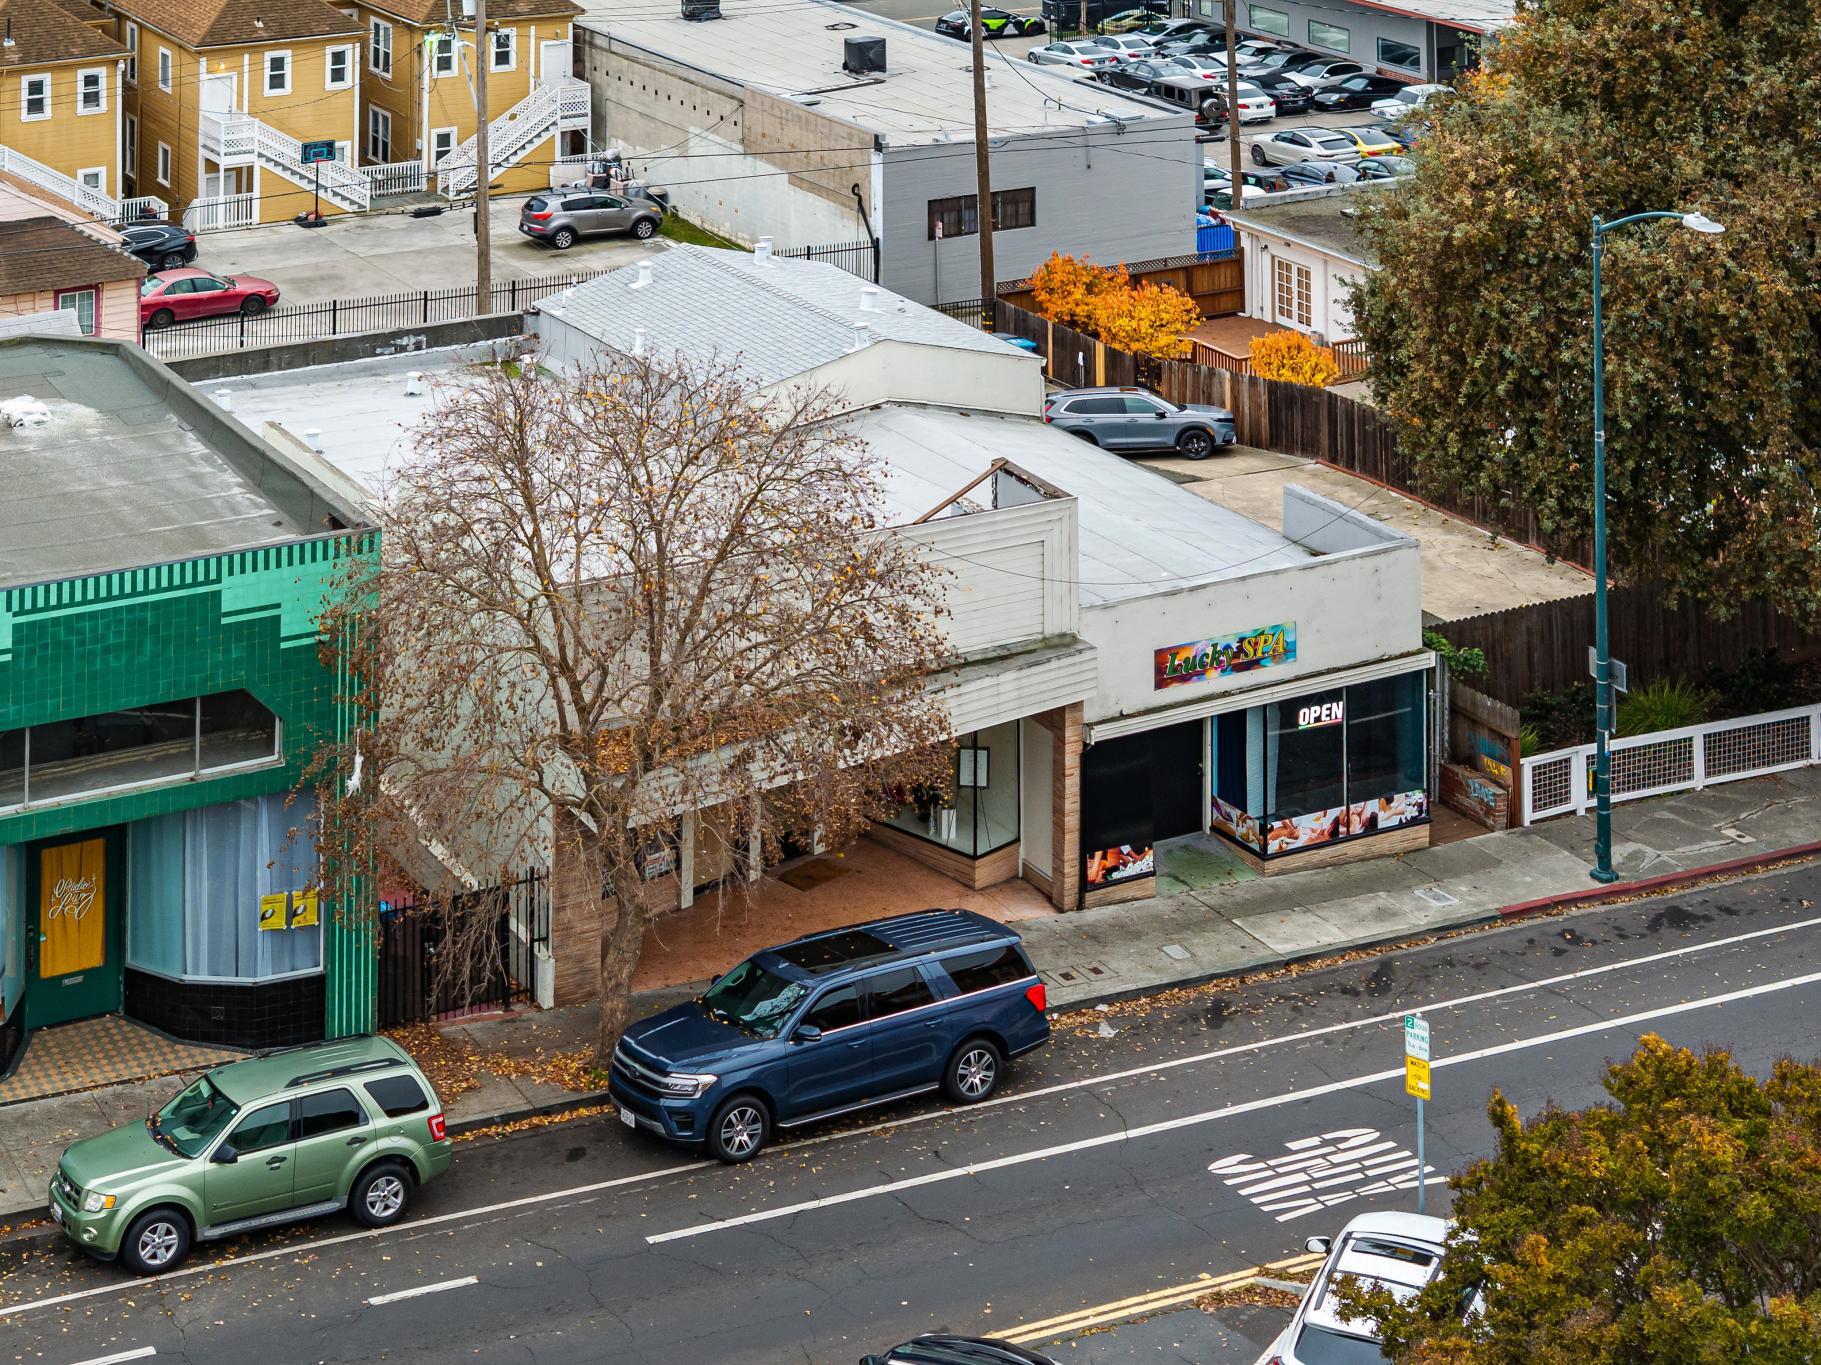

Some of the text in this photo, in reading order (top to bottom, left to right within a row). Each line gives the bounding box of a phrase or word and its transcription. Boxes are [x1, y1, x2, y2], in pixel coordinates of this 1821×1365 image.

[1165, 629, 1286, 677] Lucky SPA
[1299, 701, 1344, 726] OPEN
[1407, 1017, 1414, 1028] 2
[1406, 1030, 1429, 1044] PARKING
[1410, 1059, 1426, 1069] WATCH
[1208, 1128, 1450, 1223] XING
